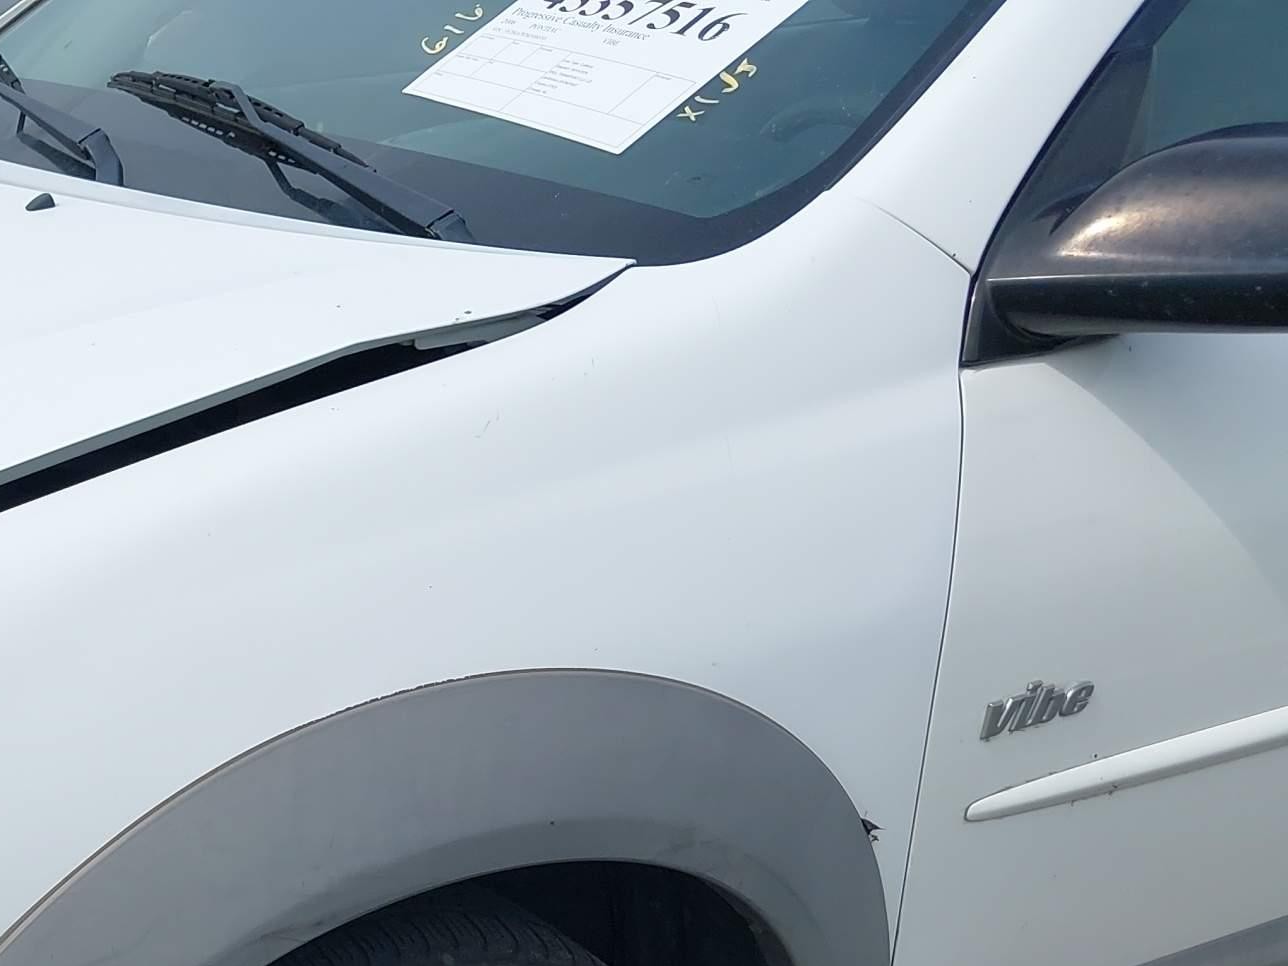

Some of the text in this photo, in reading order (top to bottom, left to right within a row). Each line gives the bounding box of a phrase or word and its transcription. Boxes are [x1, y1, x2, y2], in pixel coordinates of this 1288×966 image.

[511, 7, 563, 23] Progressive
[562, 16, 604, 33] Casualty
[602, 23, 651, 40] Insurance
[542, 0, 749, 42] 357516
